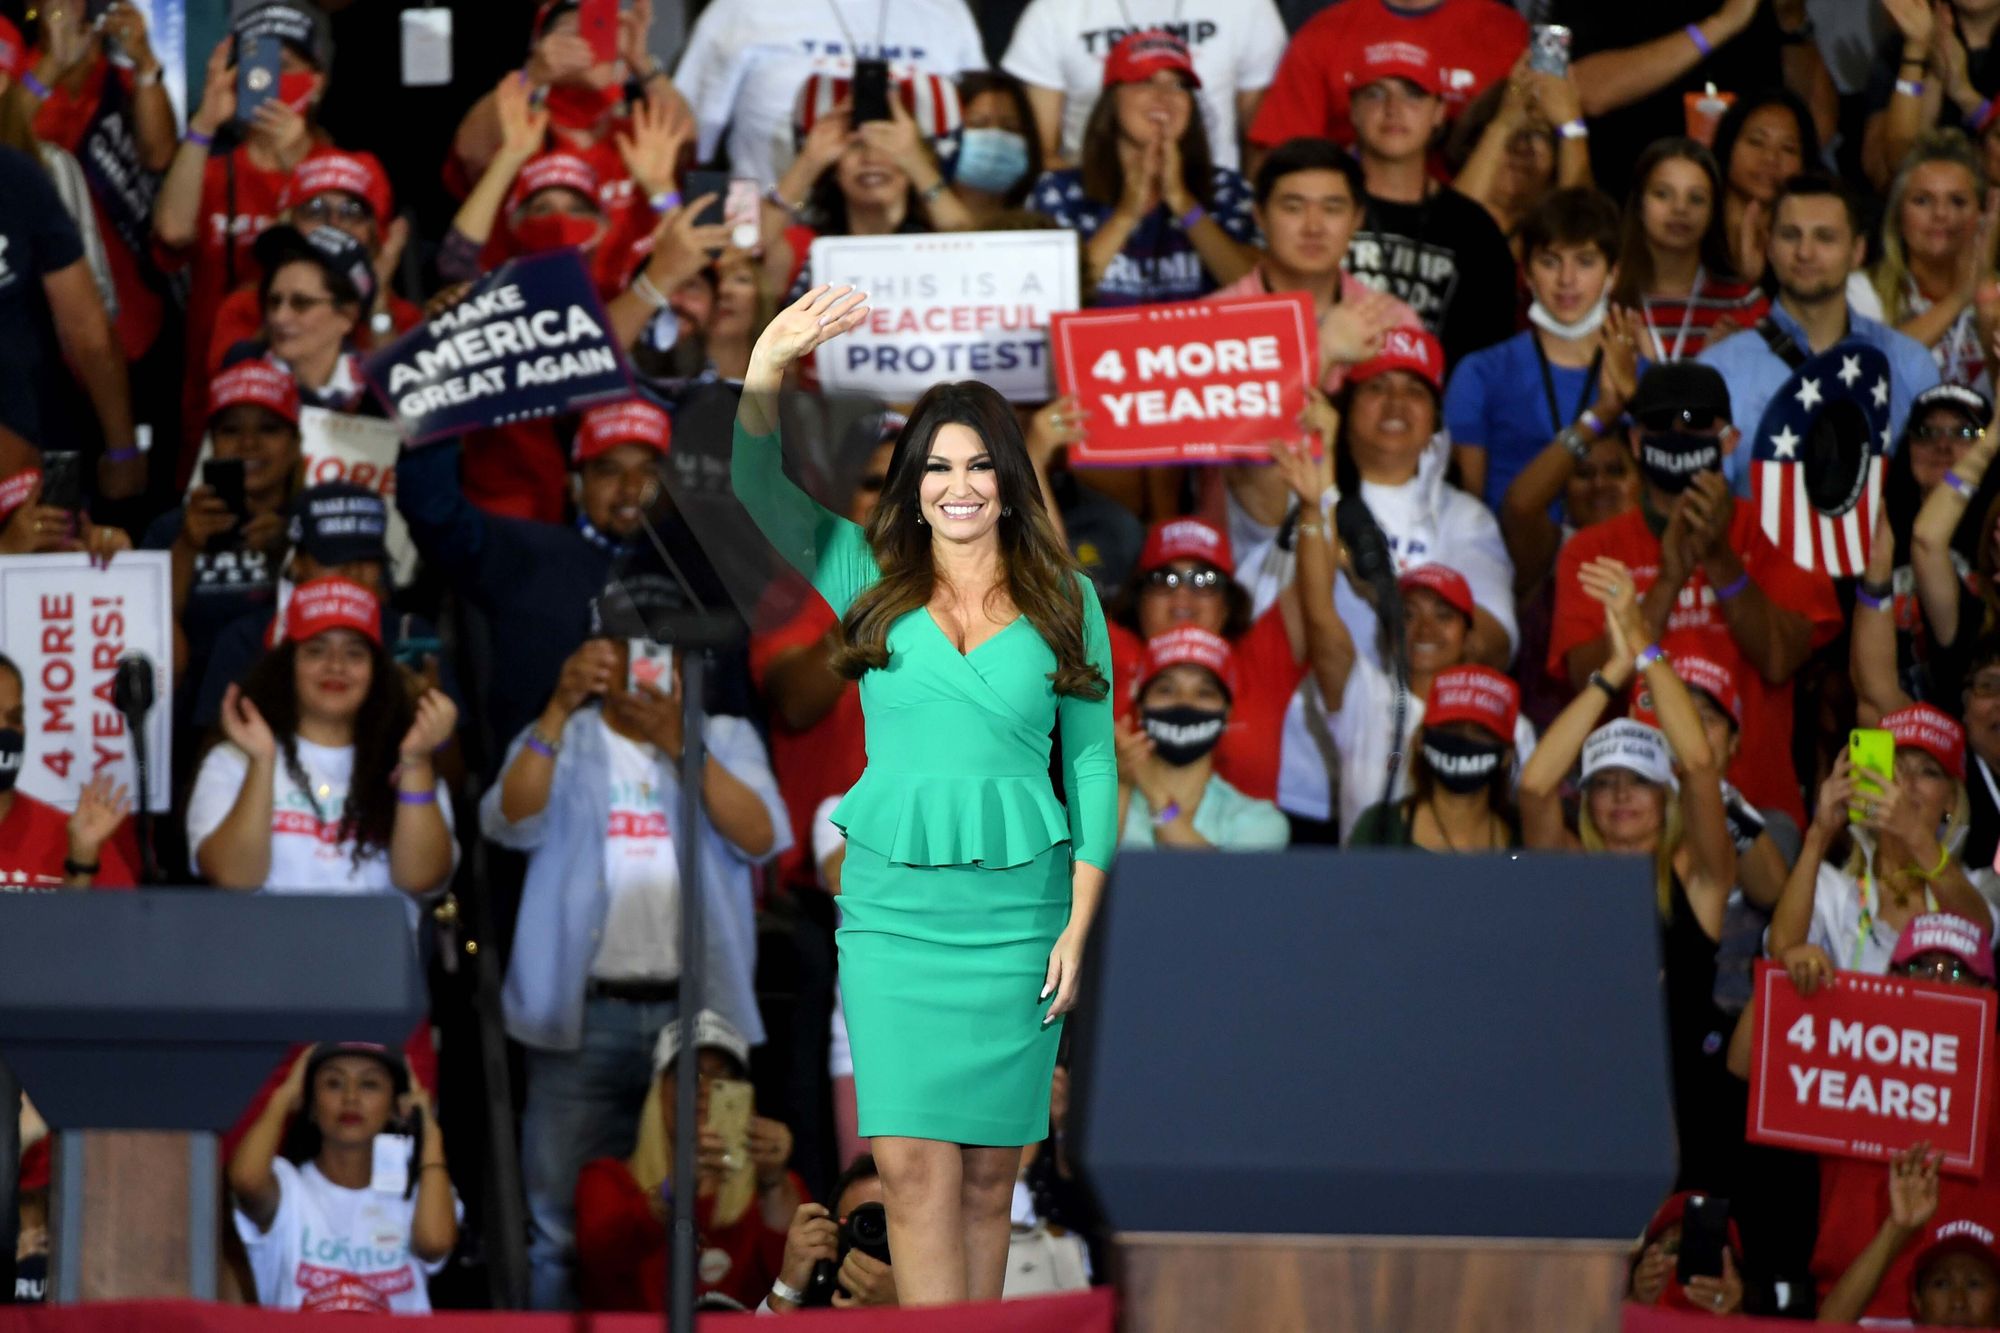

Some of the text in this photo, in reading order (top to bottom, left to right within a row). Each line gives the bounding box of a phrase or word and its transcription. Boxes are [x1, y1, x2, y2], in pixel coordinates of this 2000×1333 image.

[1079, 20, 1217, 54] TRMP
[961, 271, 997, 298] IS
[1019, 270, 1045, 296] A
[428, 284, 527, 338] MAKE
[389, 304, 603, 395] AMERICA
[847, 338, 1047, 374] PROTEST
[1091, 335, 1282, 384] 4 MORE
[400, 345, 617, 418] GREAT AGAIN
[1101, 380, 1283, 428] YEARS!
[1644, 446, 1717, 474] TRUMP
[41, 593, 75, 779] 4 MORE
[91, 595, 125, 772] YEARS!
[1147, 718, 1222, 746] TRUMP
[1912, 929, 1979, 957] TRUMP
[1787, 1013, 1960, 1074] 4 MORE
[1788, 1064, 1952, 1126] YEARS!
[1936, 1219, 1995, 1245] TRUMP
